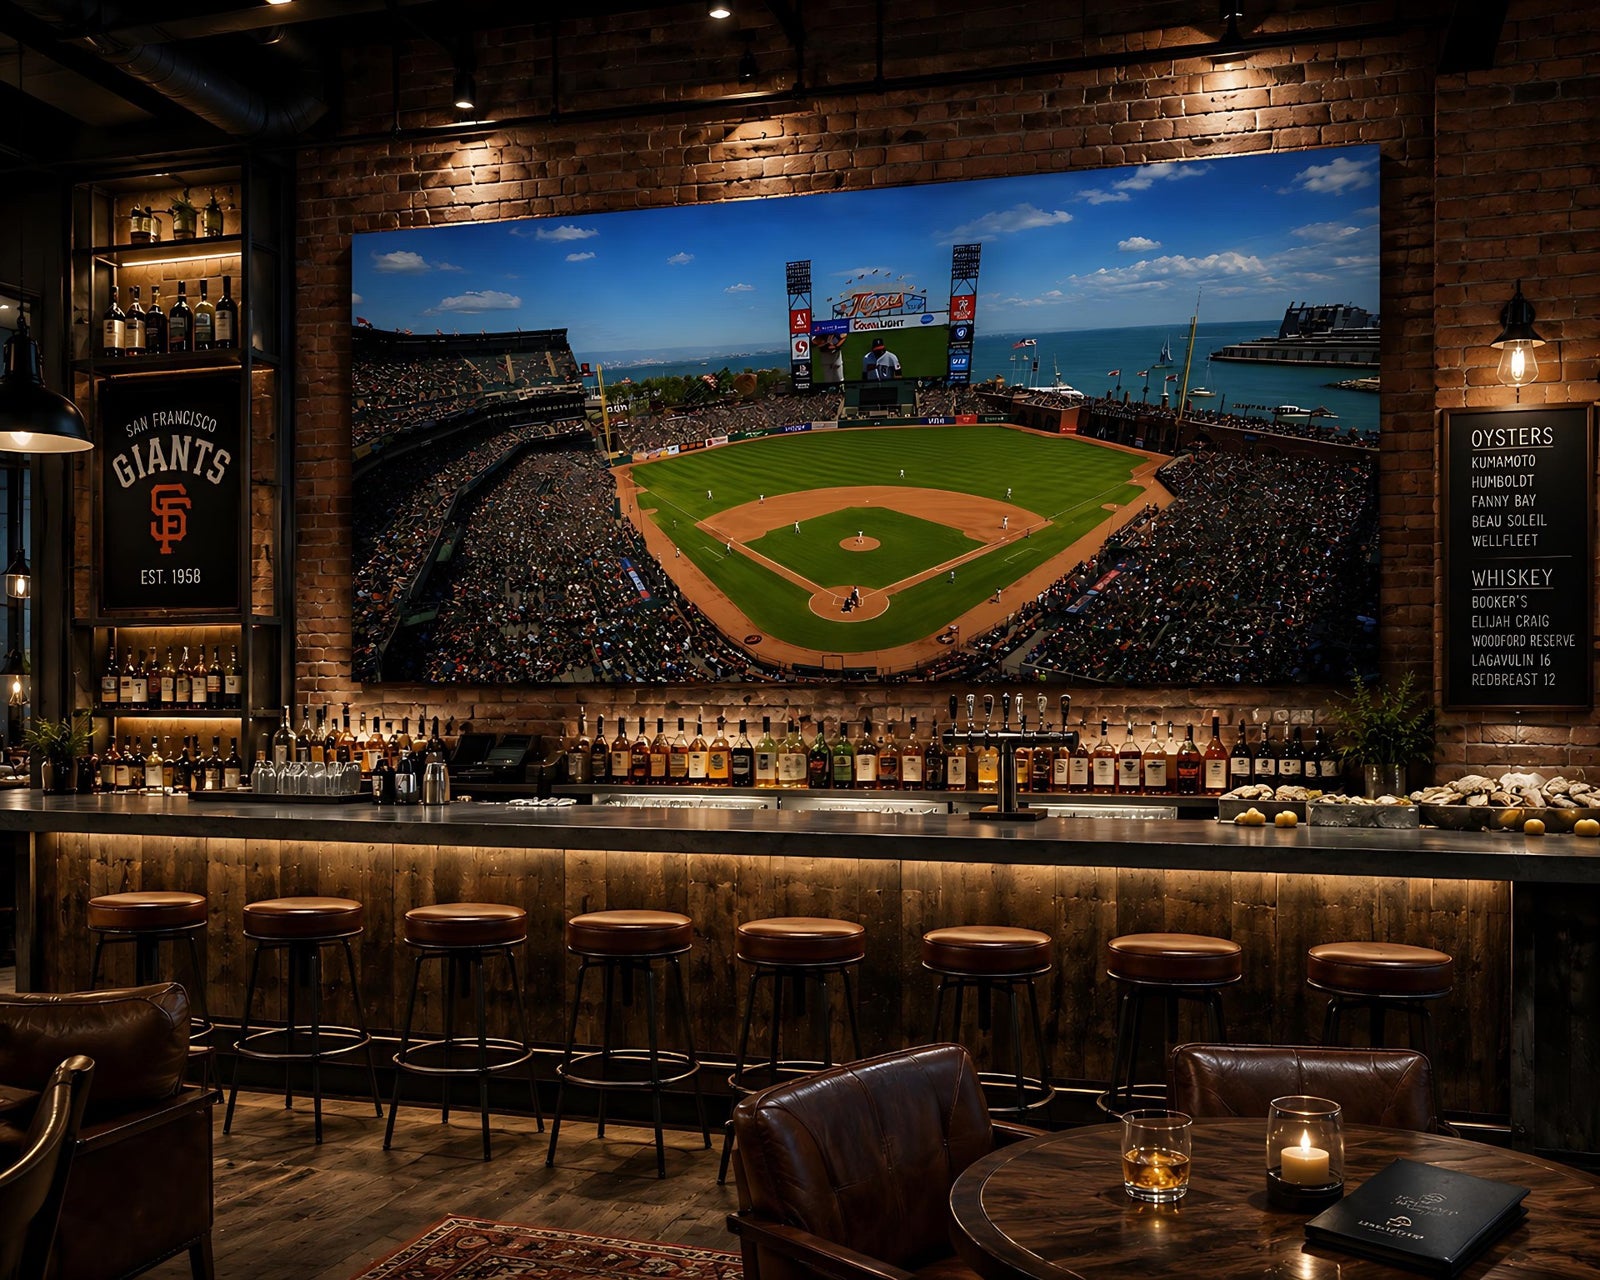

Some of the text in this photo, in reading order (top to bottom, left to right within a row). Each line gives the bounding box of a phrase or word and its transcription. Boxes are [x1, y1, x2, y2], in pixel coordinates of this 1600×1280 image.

[126, 411, 217, 437] SAN FRANCISCO
[1472, 427, 1553, 447] OYSTERS
[112, 435, 231, 488] GIANTS
[1472, 455, 1535, 468] KUMAMOTO
[1472, 474, 1534, 488] HUMBOLDT
[1472, 494, 1536, 507] FANNY BAY
[1473, 514, 1547, 527] BEAU SOLEIL
[1472, 534, 1537, 546] WELLFLEET
[141, 569, 200, 584] EST. 1958
[1472, 569, 1552, 586] WHISKEY
[1473, 595, 1527, 608] BOOKER'S
[1472, 615, 1548, 627] ELIJAH CRAIG
[1472, 635, 1575, 646] WOODFORD RESERVE
[1473, 654, 1550, 666] LAGAVULIN 16
[1473, 673, 1555, 685] REDBREAST 12
